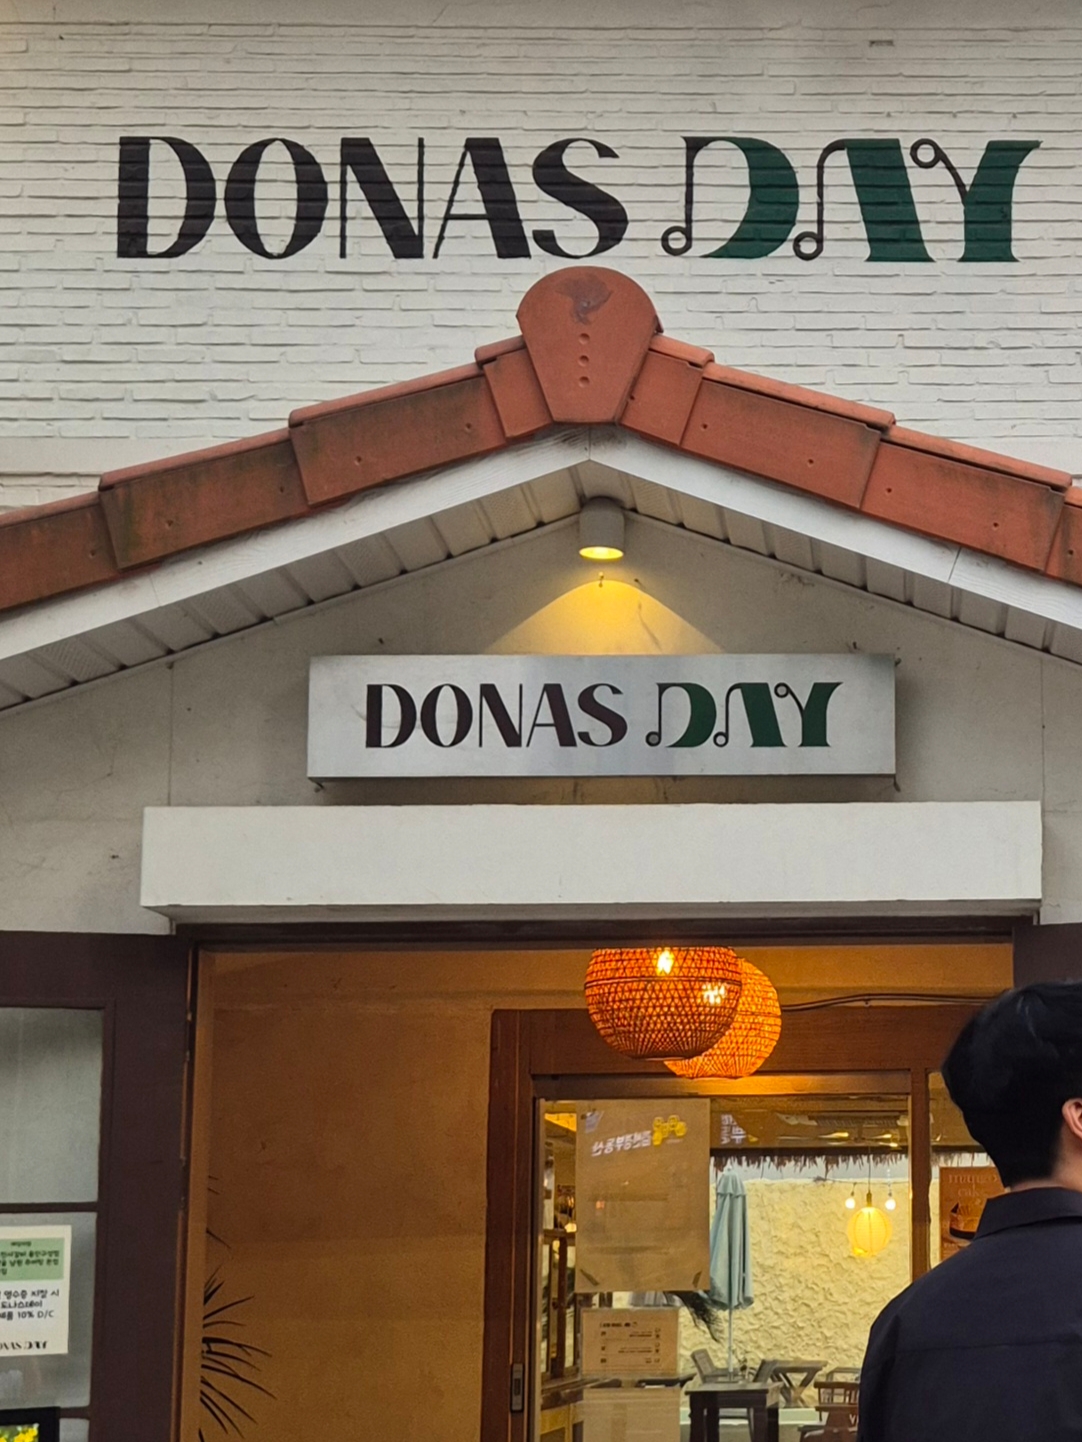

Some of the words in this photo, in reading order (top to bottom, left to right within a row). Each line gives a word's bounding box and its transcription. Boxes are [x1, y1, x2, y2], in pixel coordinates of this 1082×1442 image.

[116, 136, 629, 260] DONAS
[661, 136, 1043, 263] DAY
[365, 683, 628, 748] DONAS
[645, 682, 844, 748] DAY
[37, 1309, 55, 1319] D/C
